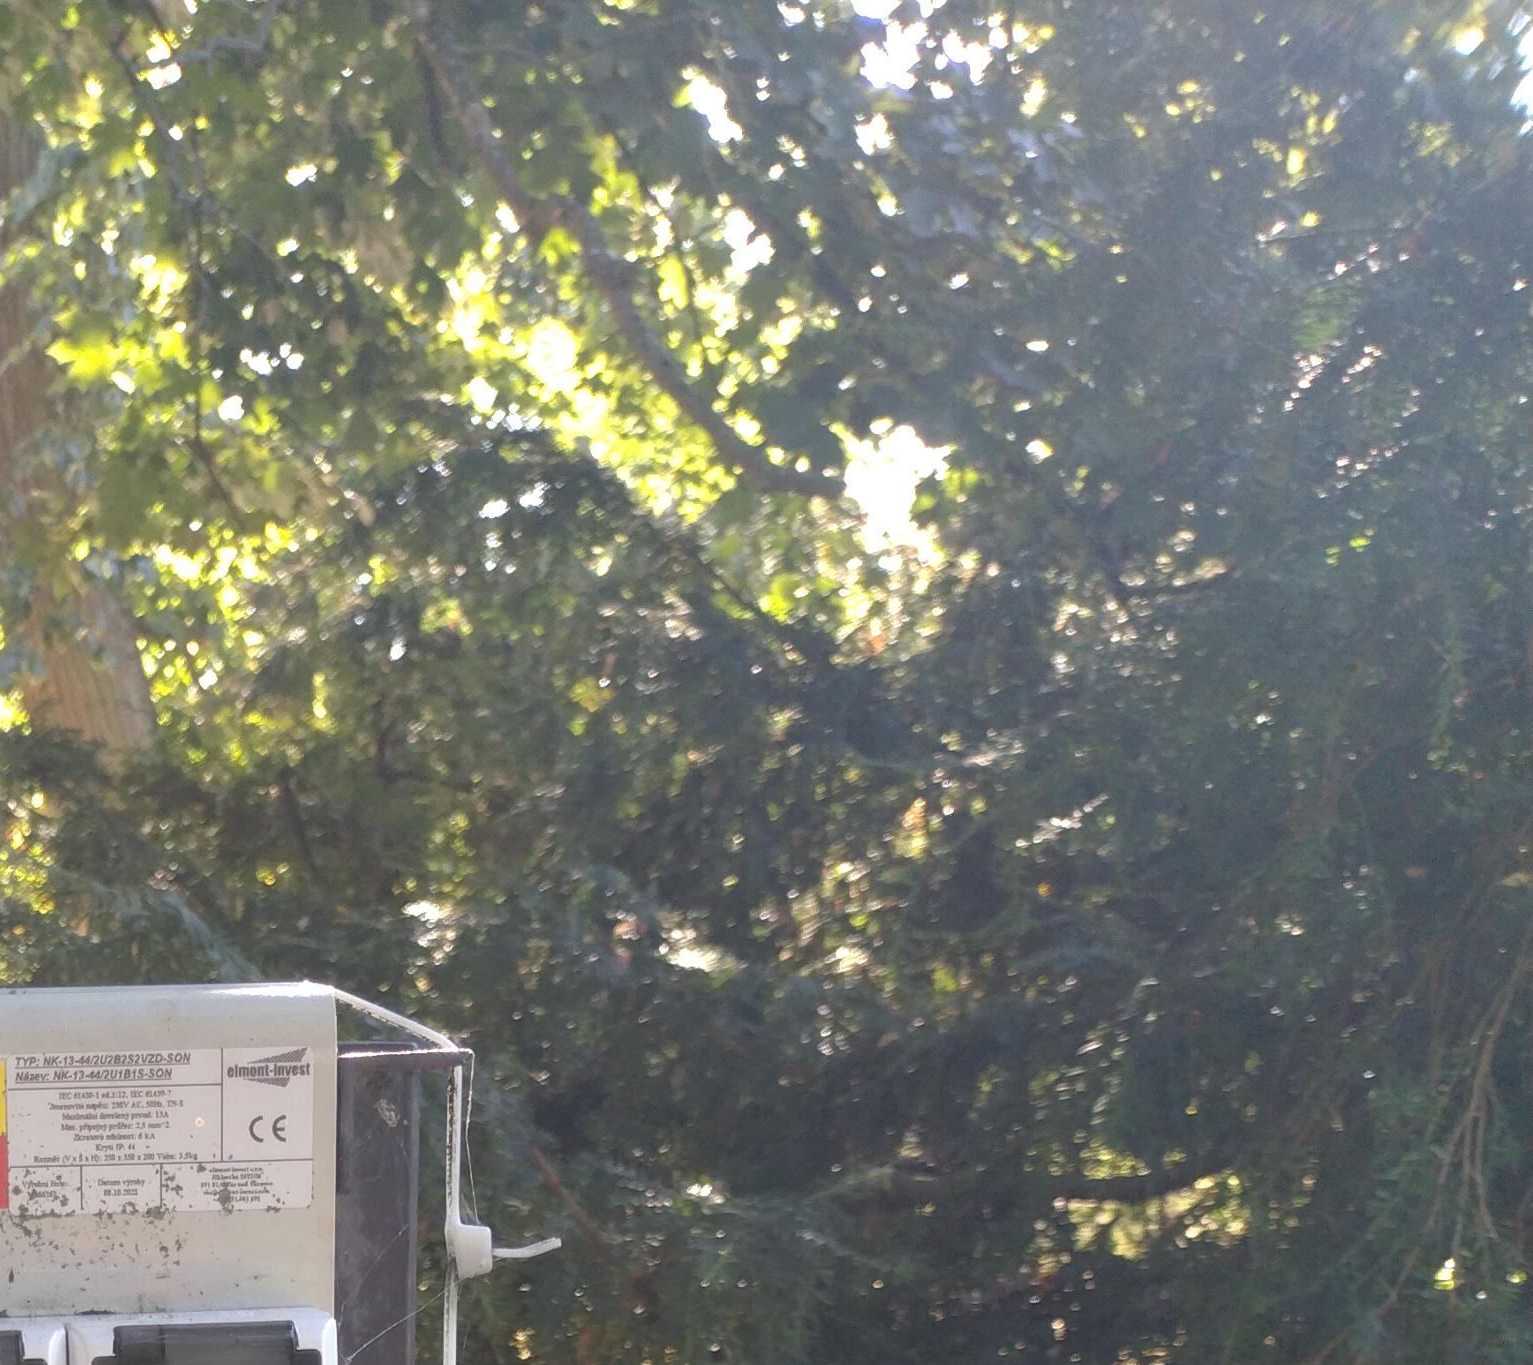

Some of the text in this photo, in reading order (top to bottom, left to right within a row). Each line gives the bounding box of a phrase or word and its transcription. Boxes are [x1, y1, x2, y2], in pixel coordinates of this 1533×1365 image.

[15, 1056, 41, 1066] TYP:
[15, 1070, 50, 1082] Název:
[227, 1063, 311, 1079] elmont-invest
